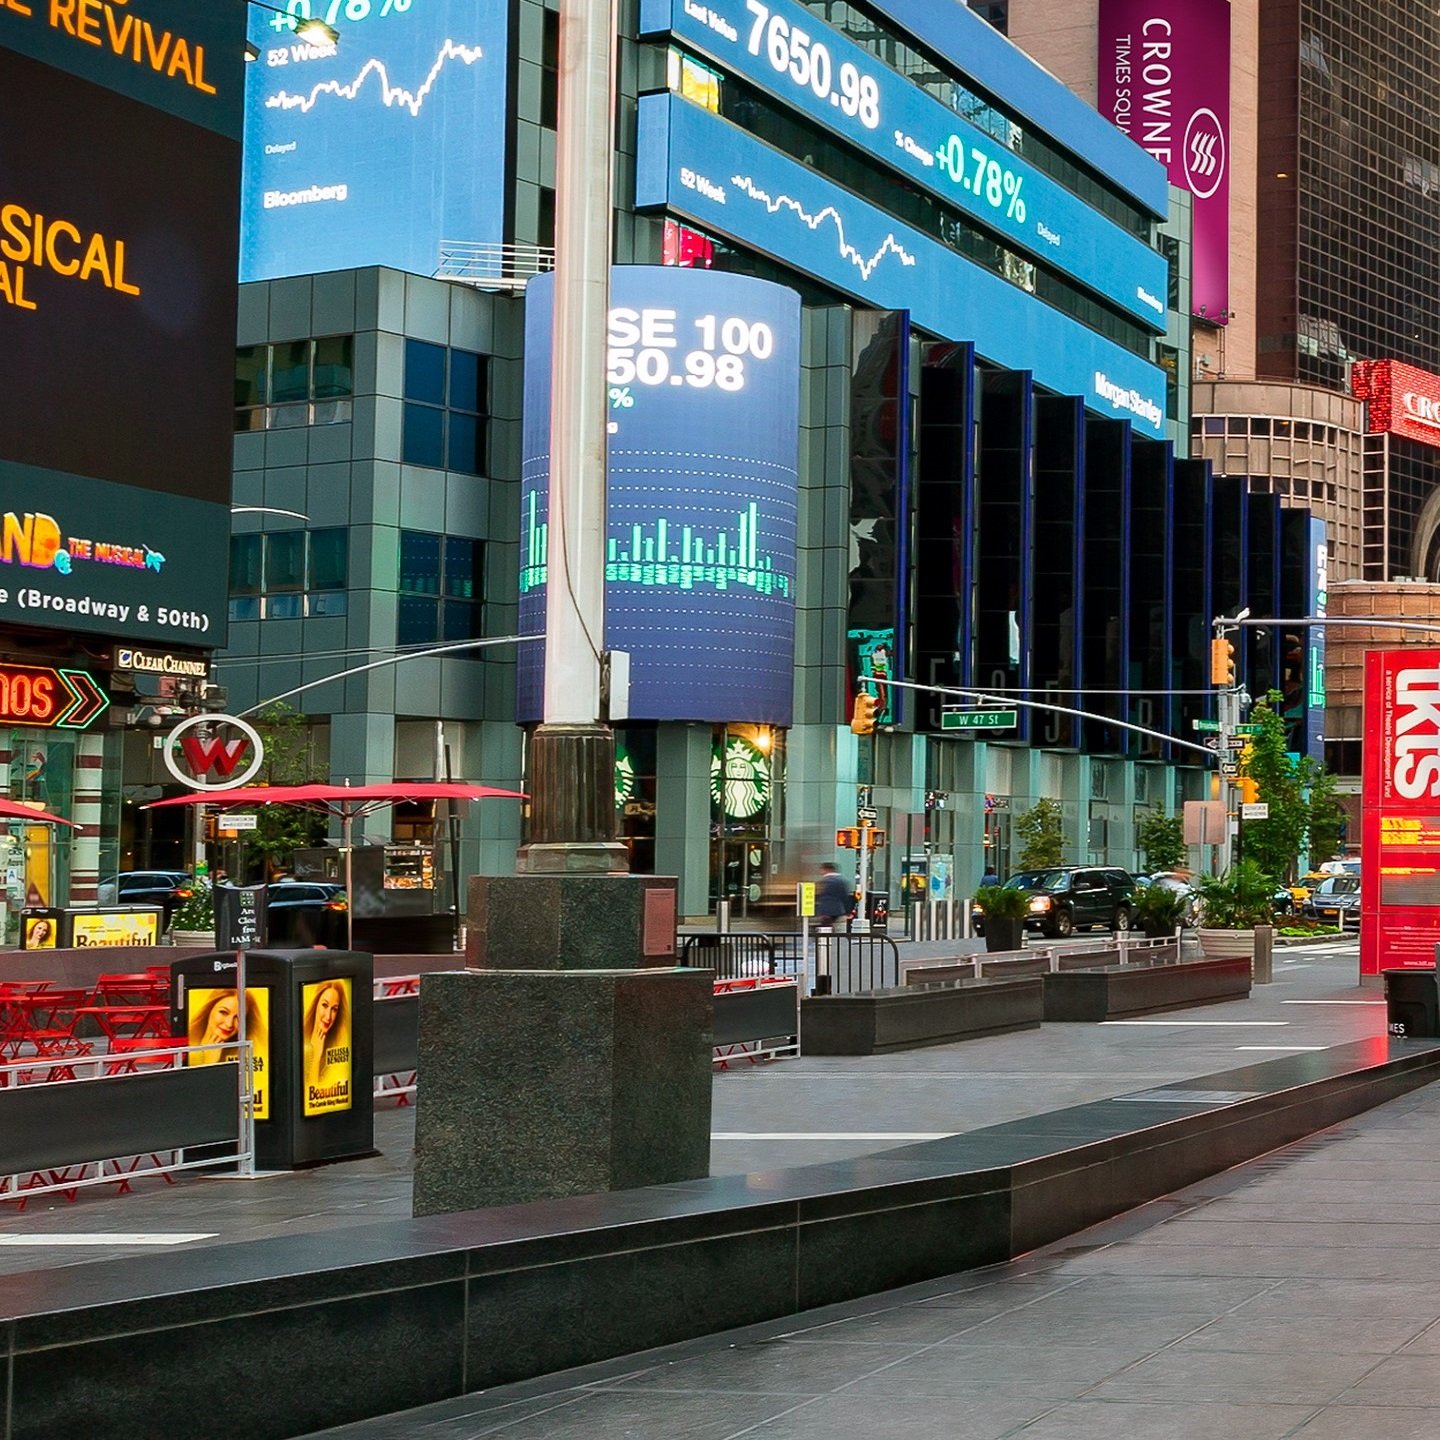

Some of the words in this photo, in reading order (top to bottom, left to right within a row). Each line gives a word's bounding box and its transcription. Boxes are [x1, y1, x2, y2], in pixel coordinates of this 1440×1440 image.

[267, 48, 289, 67] 52
[1115, 34, 1131, 84] TIMES
[264, 182, 348, 210] Bloomberg
[935, 134, 1027, 224] +0.78%
[694, 314, 773, 359] 100
[68, 537, 92, 559] THE
[17, 587, 130, 622] (Broadway
[137, 605, 150, 623] &
[156, 607, 210, 633] 50th)
[959, 715, 970, 726] W
[972, 714, 985, 726] 47
[987, 714, 999, 726] St
[180, 735, 250, 776] W
[308, 1080, 349, 1102] Beautiful
